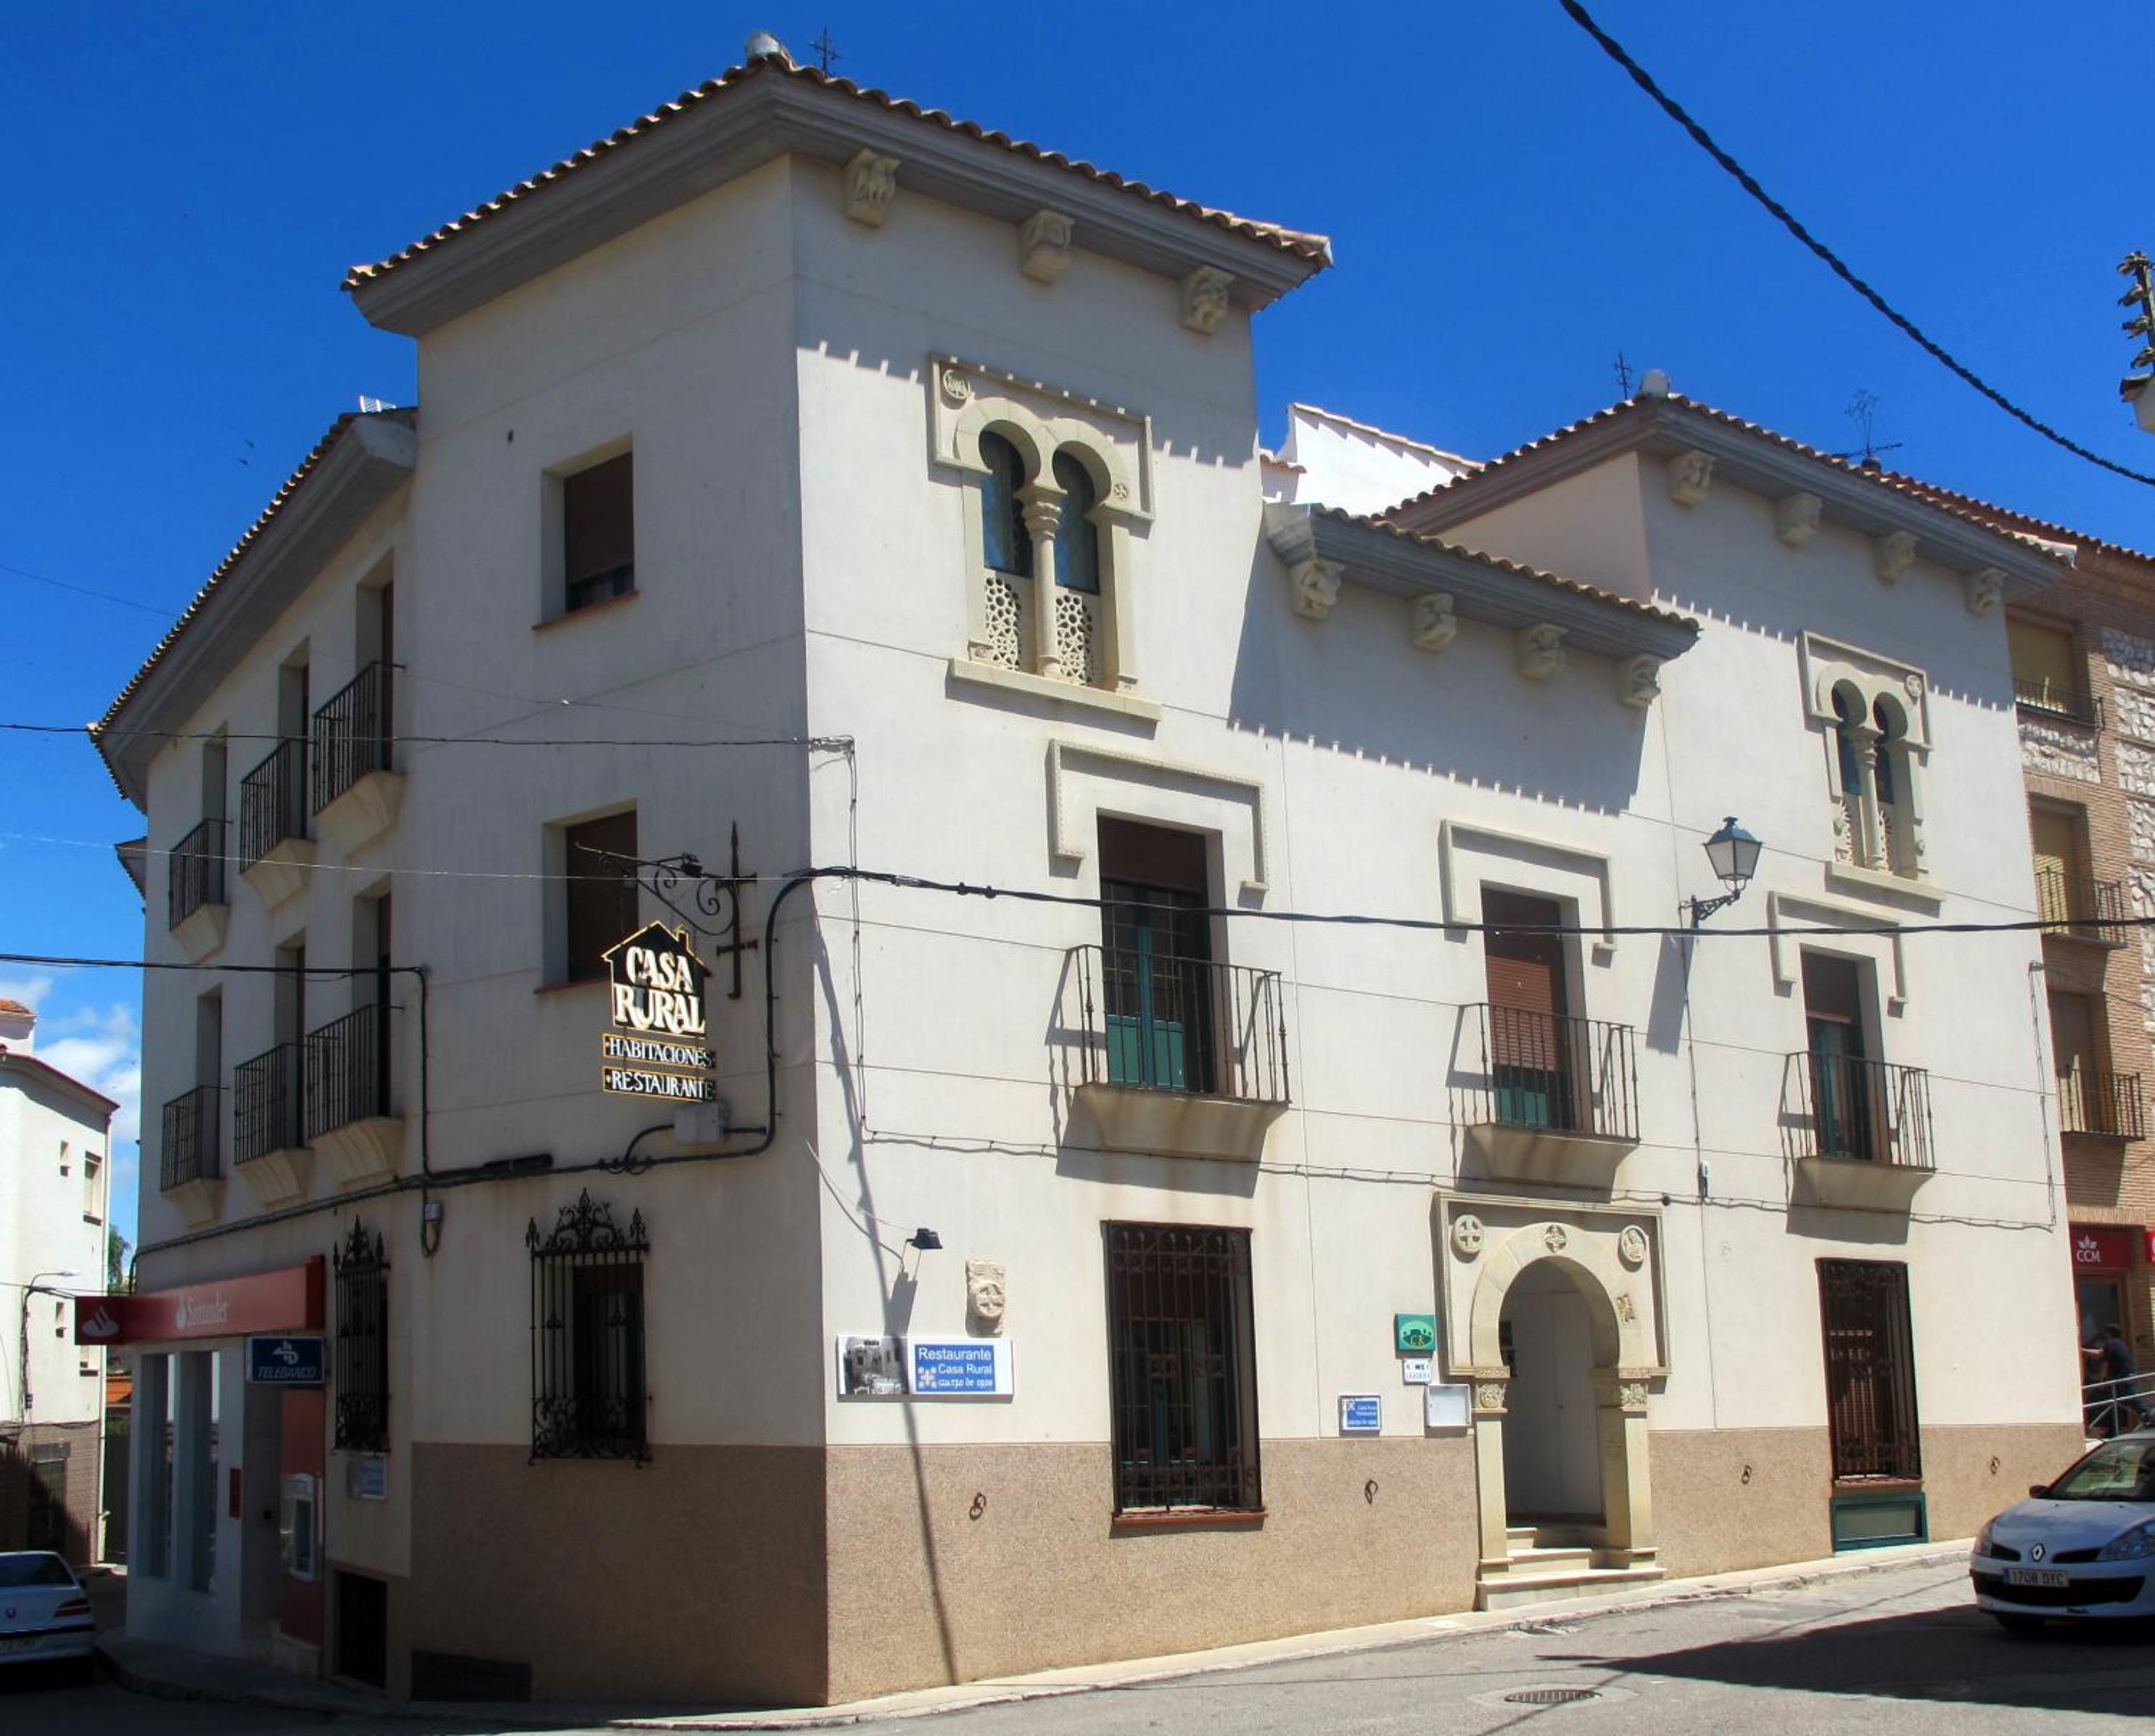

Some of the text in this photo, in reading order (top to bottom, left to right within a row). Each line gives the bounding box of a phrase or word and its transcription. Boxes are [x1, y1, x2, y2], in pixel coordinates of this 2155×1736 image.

[626, 946, 693, 993] CASA
[614, 983, 706, 1034] RURAL
[610, 1037, 712, 1068] HABITACIONES
[611, 1070, 714, 1100] RESTAURANTE
[2077, 1250, 2101, 1262] CCM
[186, 1290, 228, 1325] Santander
[918, 1347, 992, 1360] Restaurante
[257, 1365, 317, 1379] TELEBANCO
[938, 1364, 992, 1375] Casa Rural
